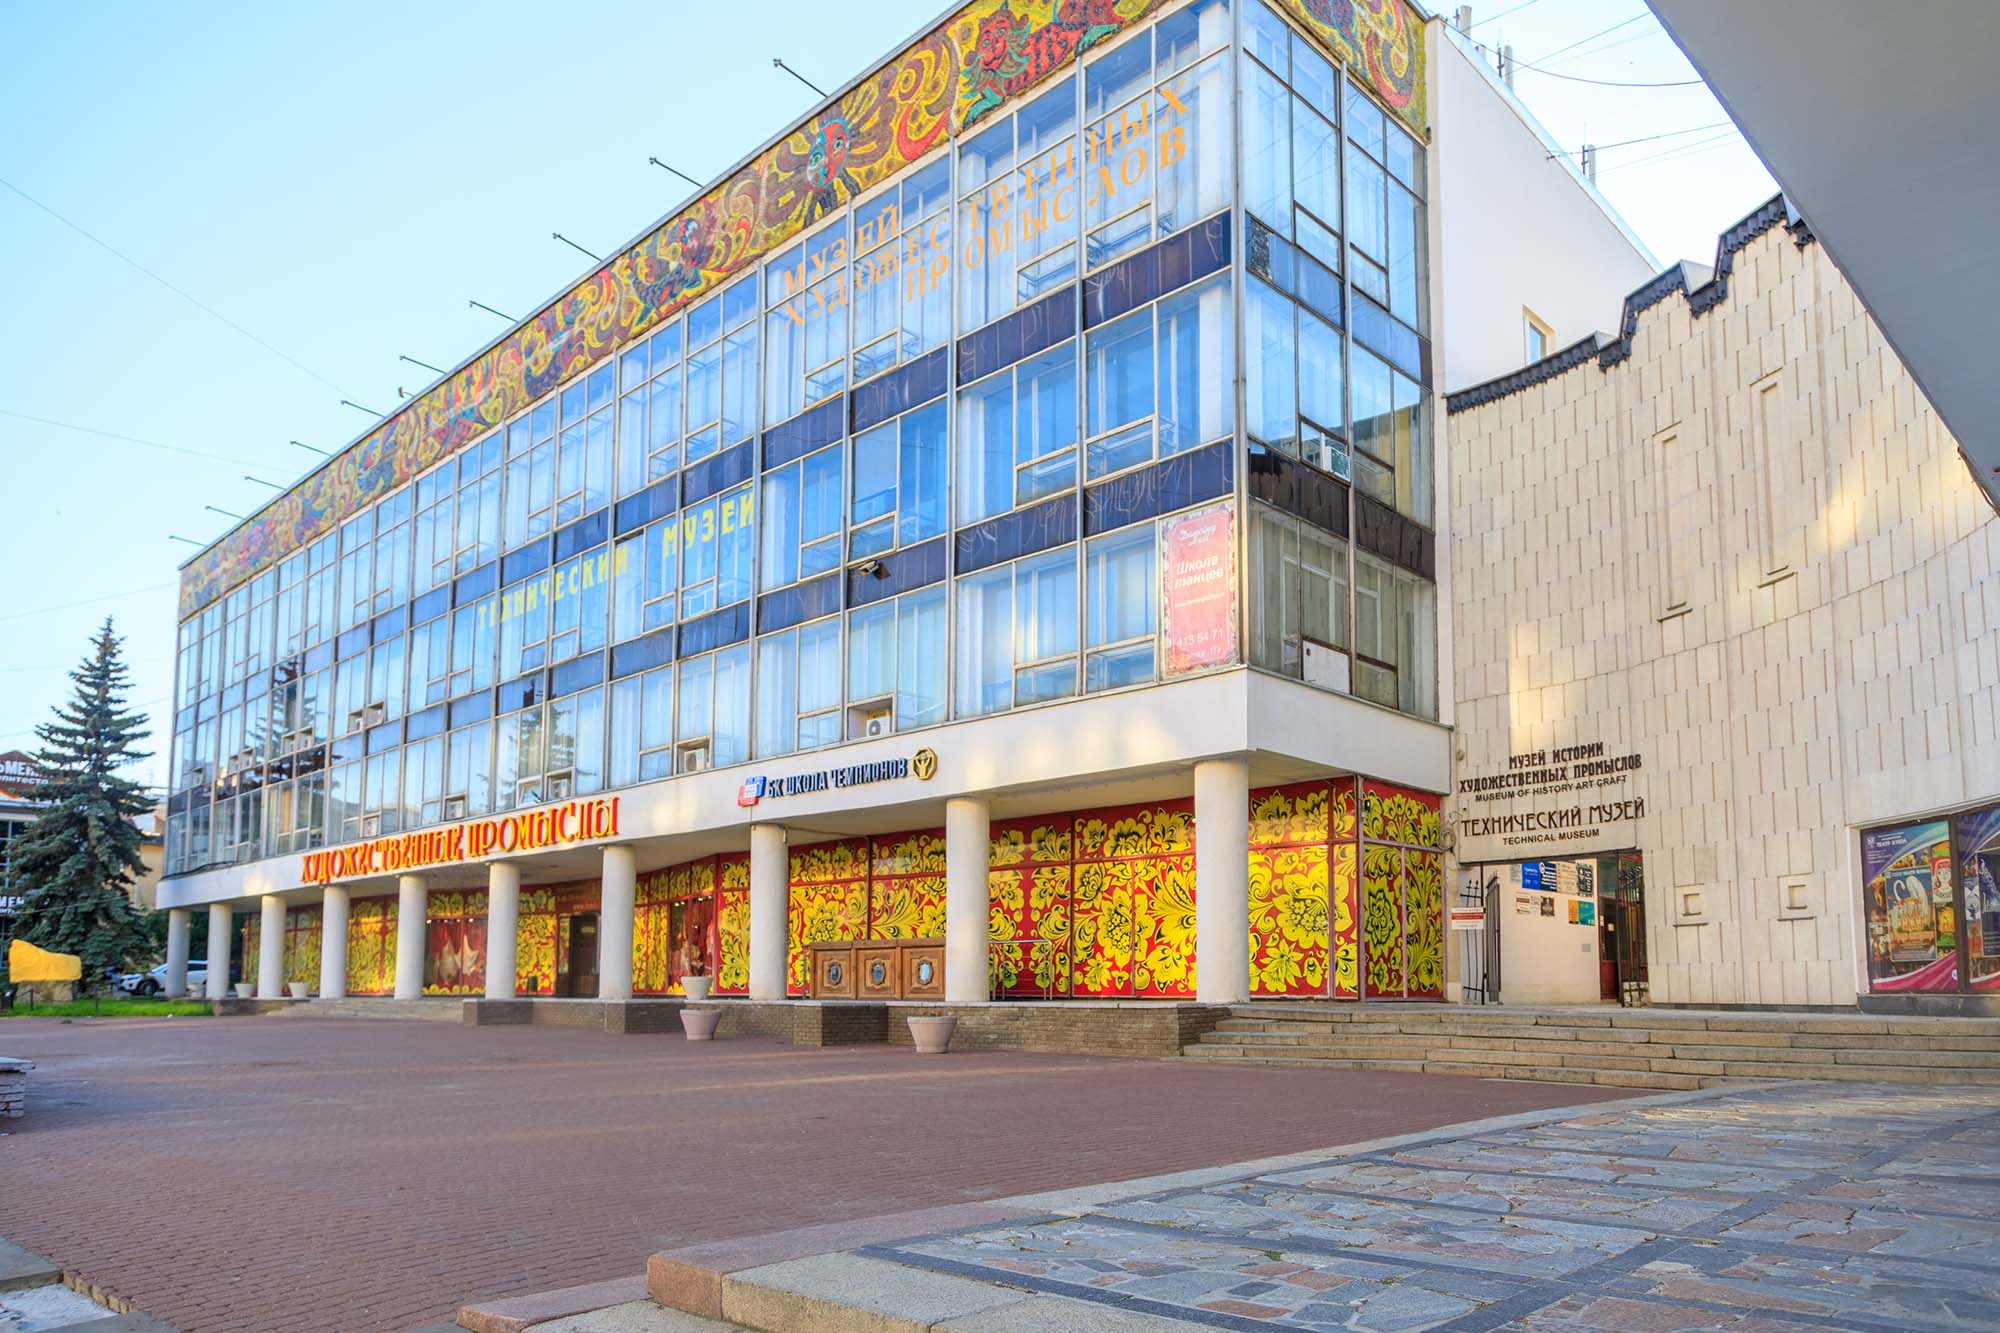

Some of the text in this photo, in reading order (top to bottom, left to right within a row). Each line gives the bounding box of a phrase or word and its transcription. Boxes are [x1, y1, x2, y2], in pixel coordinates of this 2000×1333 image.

[784, 80, 1189, 334] ХУДОЖЕСТВЕННЫХ
[906, 126, 1187, 302] ПРОМЫСЛОВ
[784, 203, 898, 298] МУЗЕЙ
[663, 481, 753, 558] МУЗЕЙ
[1175, 555, 1219, 575] Школа
[1459, 753, 1642, 793] ХУДОЖЕСТВЕННЫХ ПРОМЫСЛОВ
[1508, 741, 1604, 770] МУЗЕЙ ИСТОРИИ
[786, 771, 829, 795] ШКОЛА
[830, 757, 909, 789] ЧЕМПИОНОВ
[1475, 774, 1628, 803] MUSEUM OF HISTORY ART CRAFT
[1461, 796, 1646, 837] ТЕХНИЧЕСКИЙ МУЗЕЙ
[300, 796, 621, 885] ХУДОЖЕСТВЕННЫЕ ПРОМЫСЛЫ
[1502, 828, 1600, 846] TECHNICAL MUSEUM
